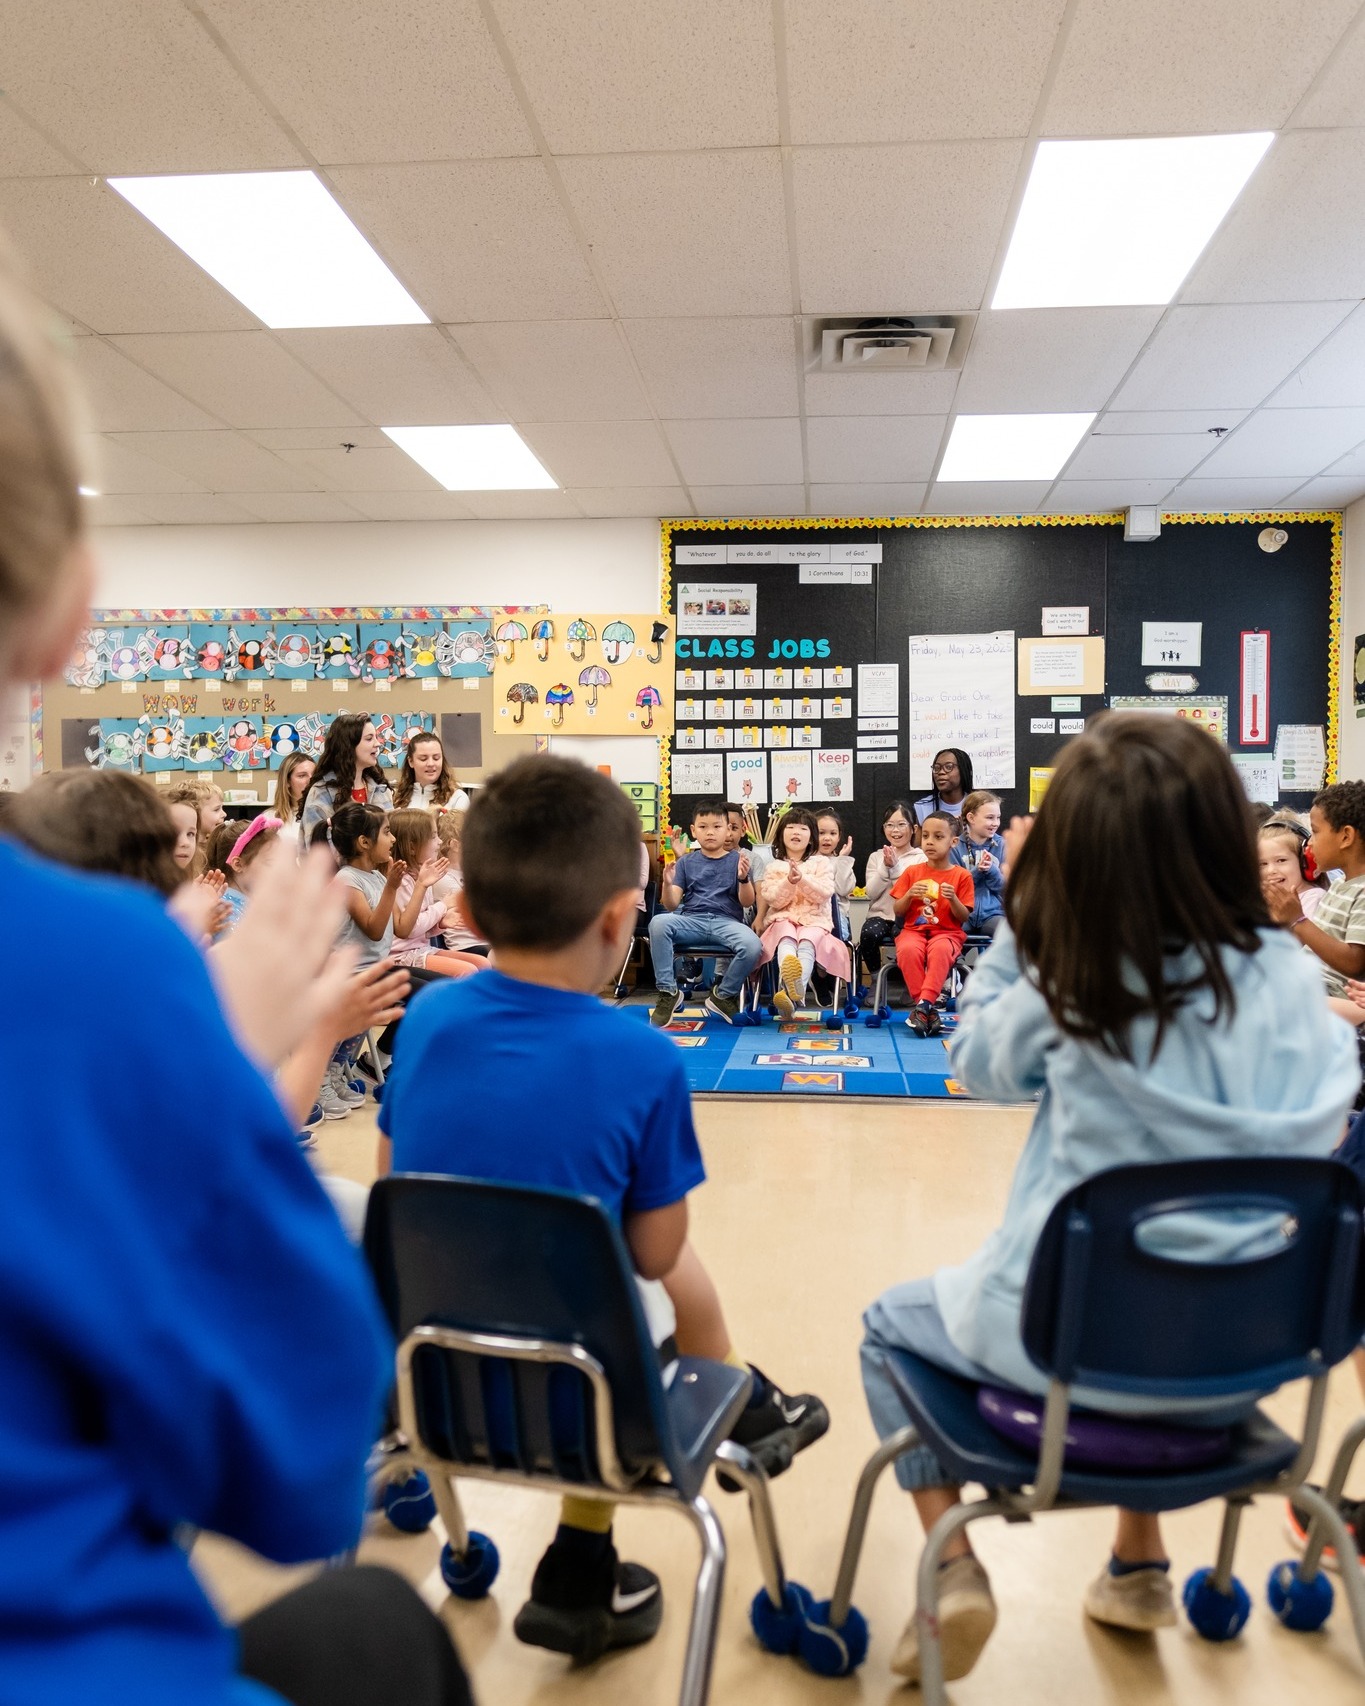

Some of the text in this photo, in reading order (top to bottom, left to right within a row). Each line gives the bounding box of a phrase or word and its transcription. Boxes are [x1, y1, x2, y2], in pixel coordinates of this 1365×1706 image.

[675, 638, 831, 659] CLASS JOBS
[911, 643, 1013, 658] Friday, May 23, 2025
[1162, 679, 1182, 688] MAY
[222, 693, 276, 712] work
[911, 692, 934, 703] Dear
[940, 690, 967, 701] Grade
[912, 711, 919, 721] I
[925, 711, 947, 721] would
[953, 709, 969, 721] like
[972, 710, 983, 720] to
[1032, 721, 1084, 730] could would
[946, 730, 954, 739] at
[958, 729, 970, 739] the
[973, 729, 989, 742] park
[994, 727, 1001, 739] I
[774, 754, 809, 765] Always
[818, 753, 850, 765] Keep
[912, 750, 930, 759] could
[730, 757, 763, 772] good
[787, 1073, 837, 1085] W
